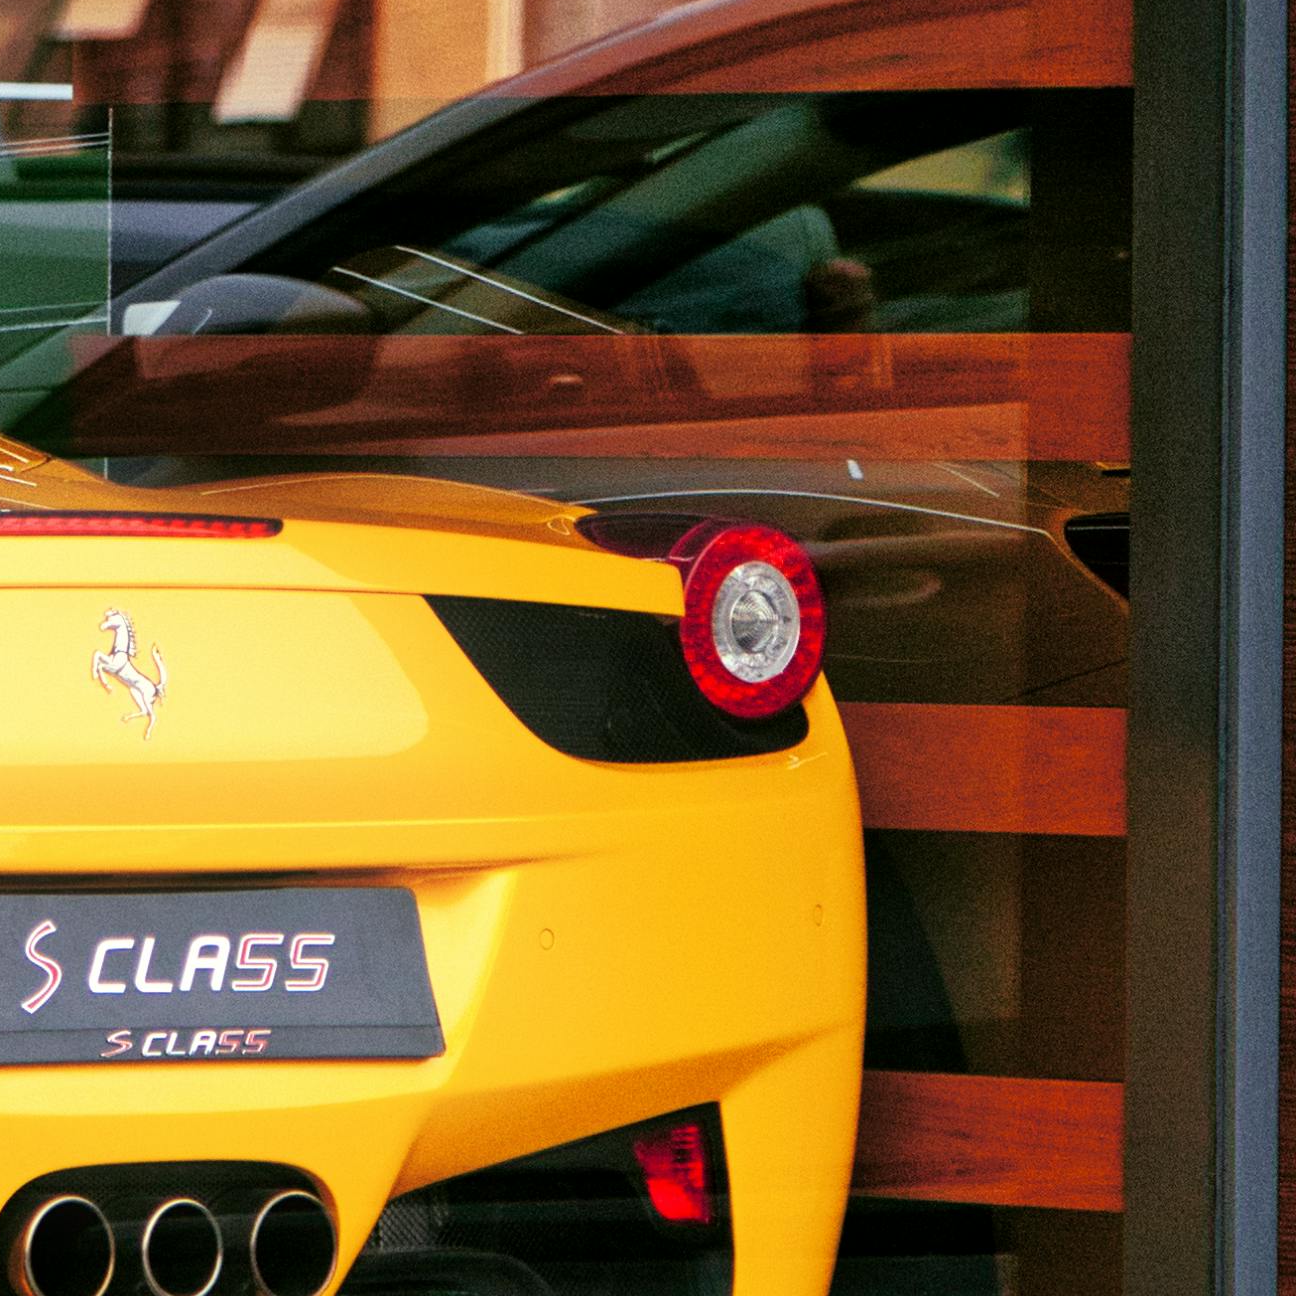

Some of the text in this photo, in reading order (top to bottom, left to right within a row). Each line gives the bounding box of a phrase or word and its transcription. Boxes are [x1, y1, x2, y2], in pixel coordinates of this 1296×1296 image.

[19, 918, 336, 1014] S CLASS
[100, 1029, 272, 1057] S CLASS
